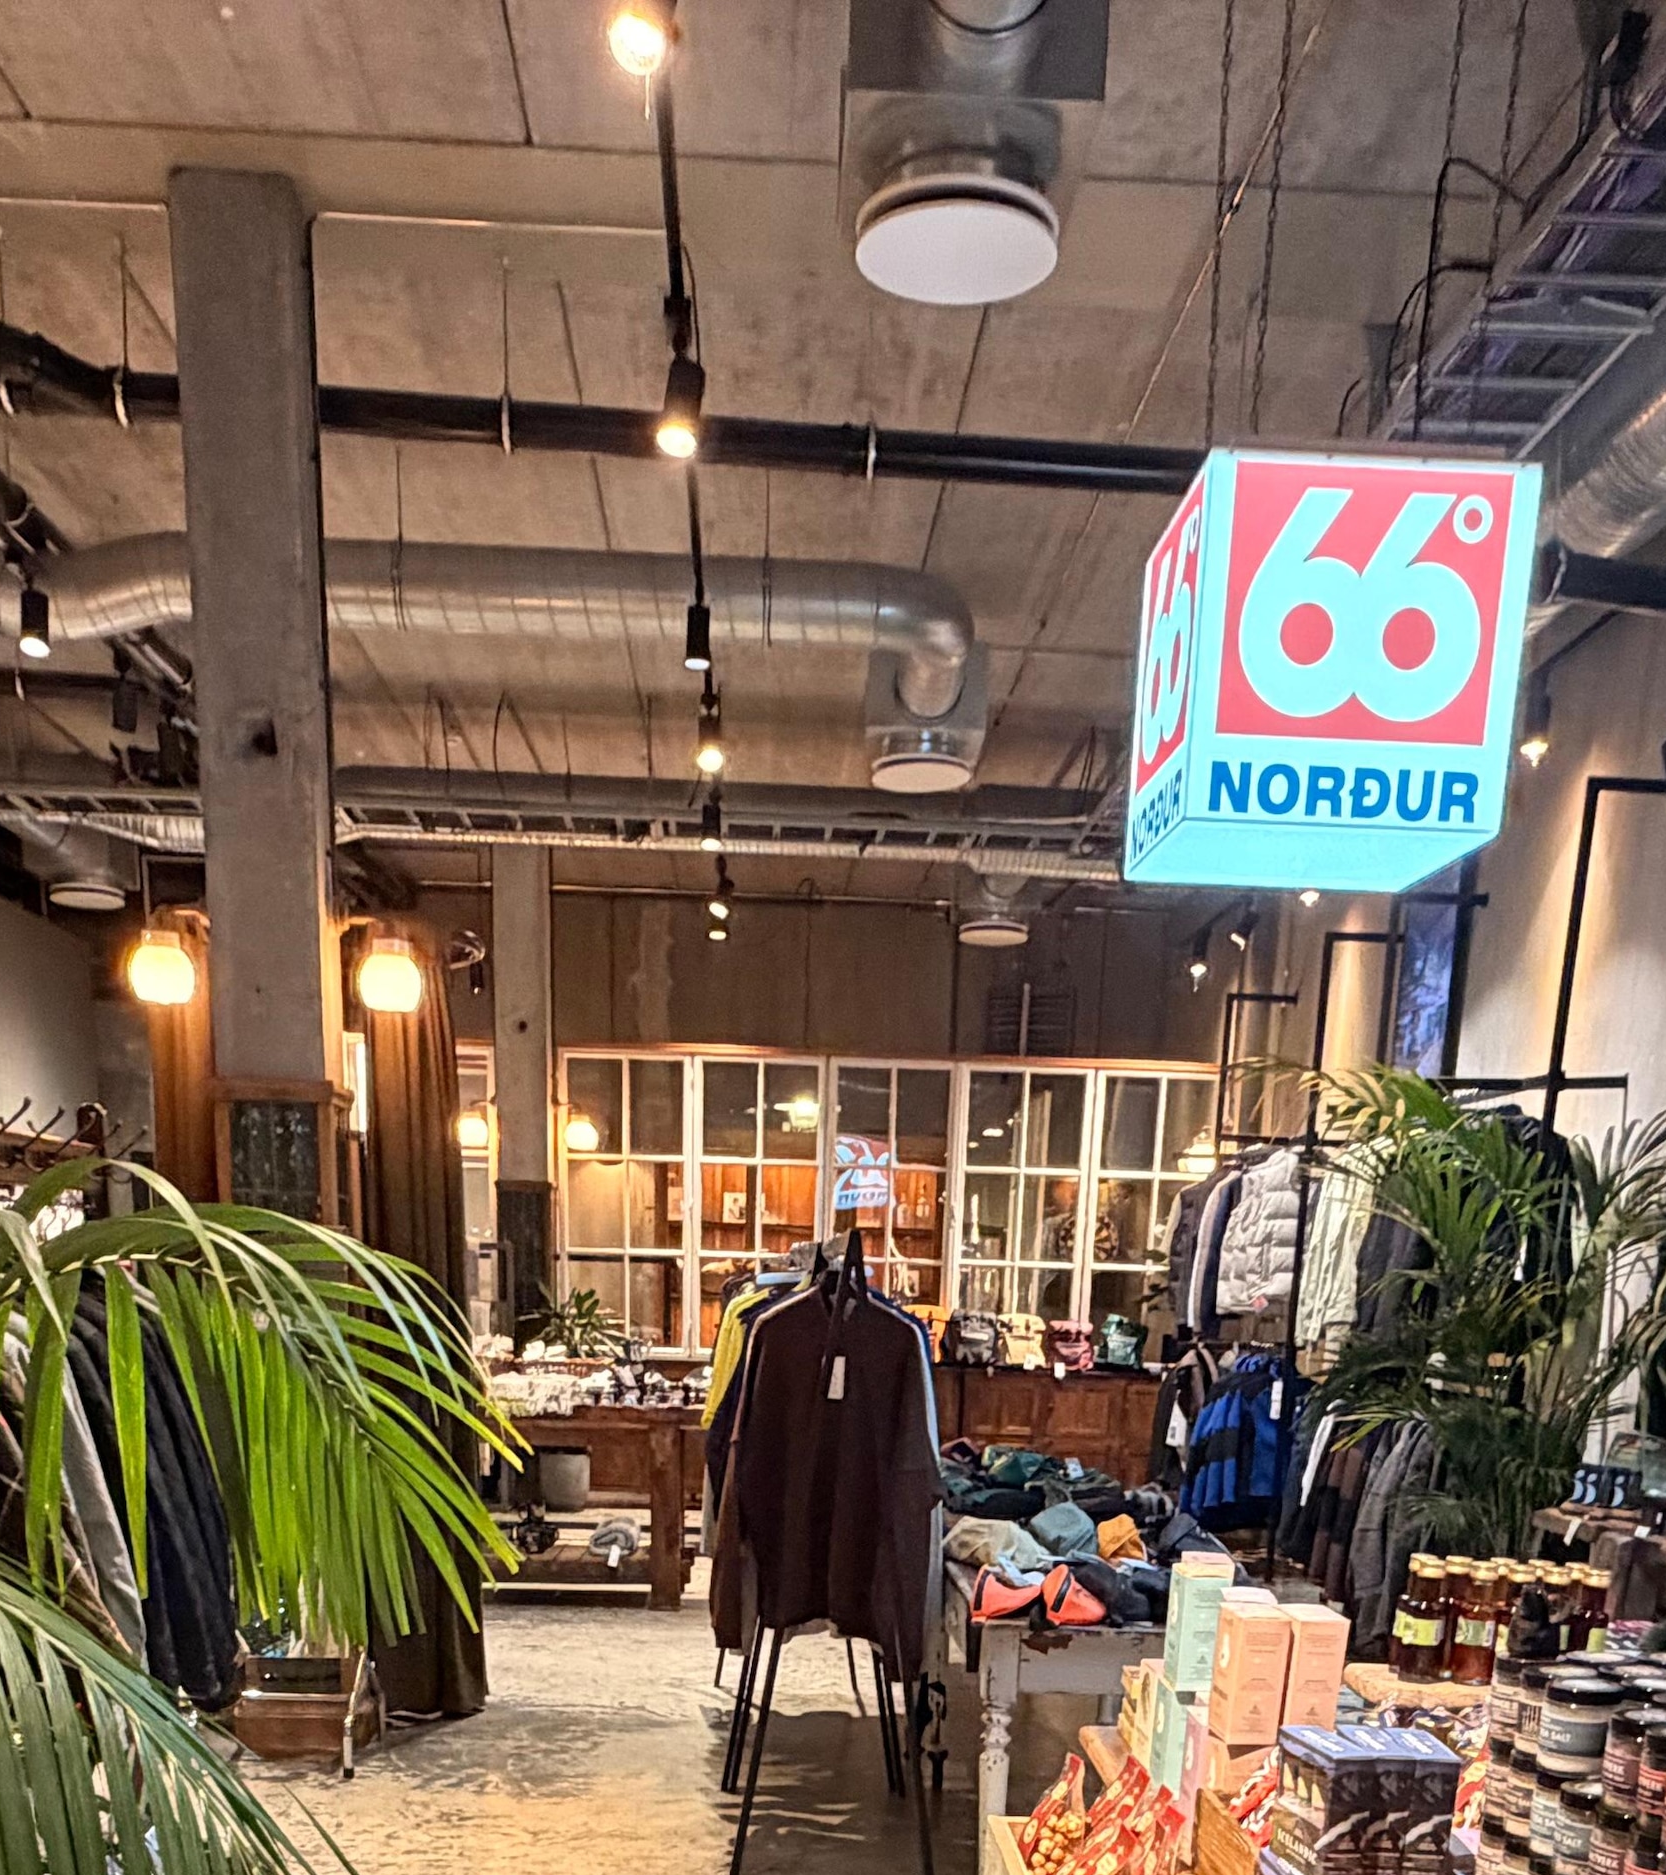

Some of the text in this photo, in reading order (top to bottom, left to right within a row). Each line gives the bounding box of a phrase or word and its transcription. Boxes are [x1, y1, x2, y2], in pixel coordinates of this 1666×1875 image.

[1208, 760, 1480, 823] NORÐUR
[1130, 767, 1183, 863] NORÐUR
[1549, 1728, 1573, 1744] SALT
[1562, 1834, 1583, 1848] SALT
